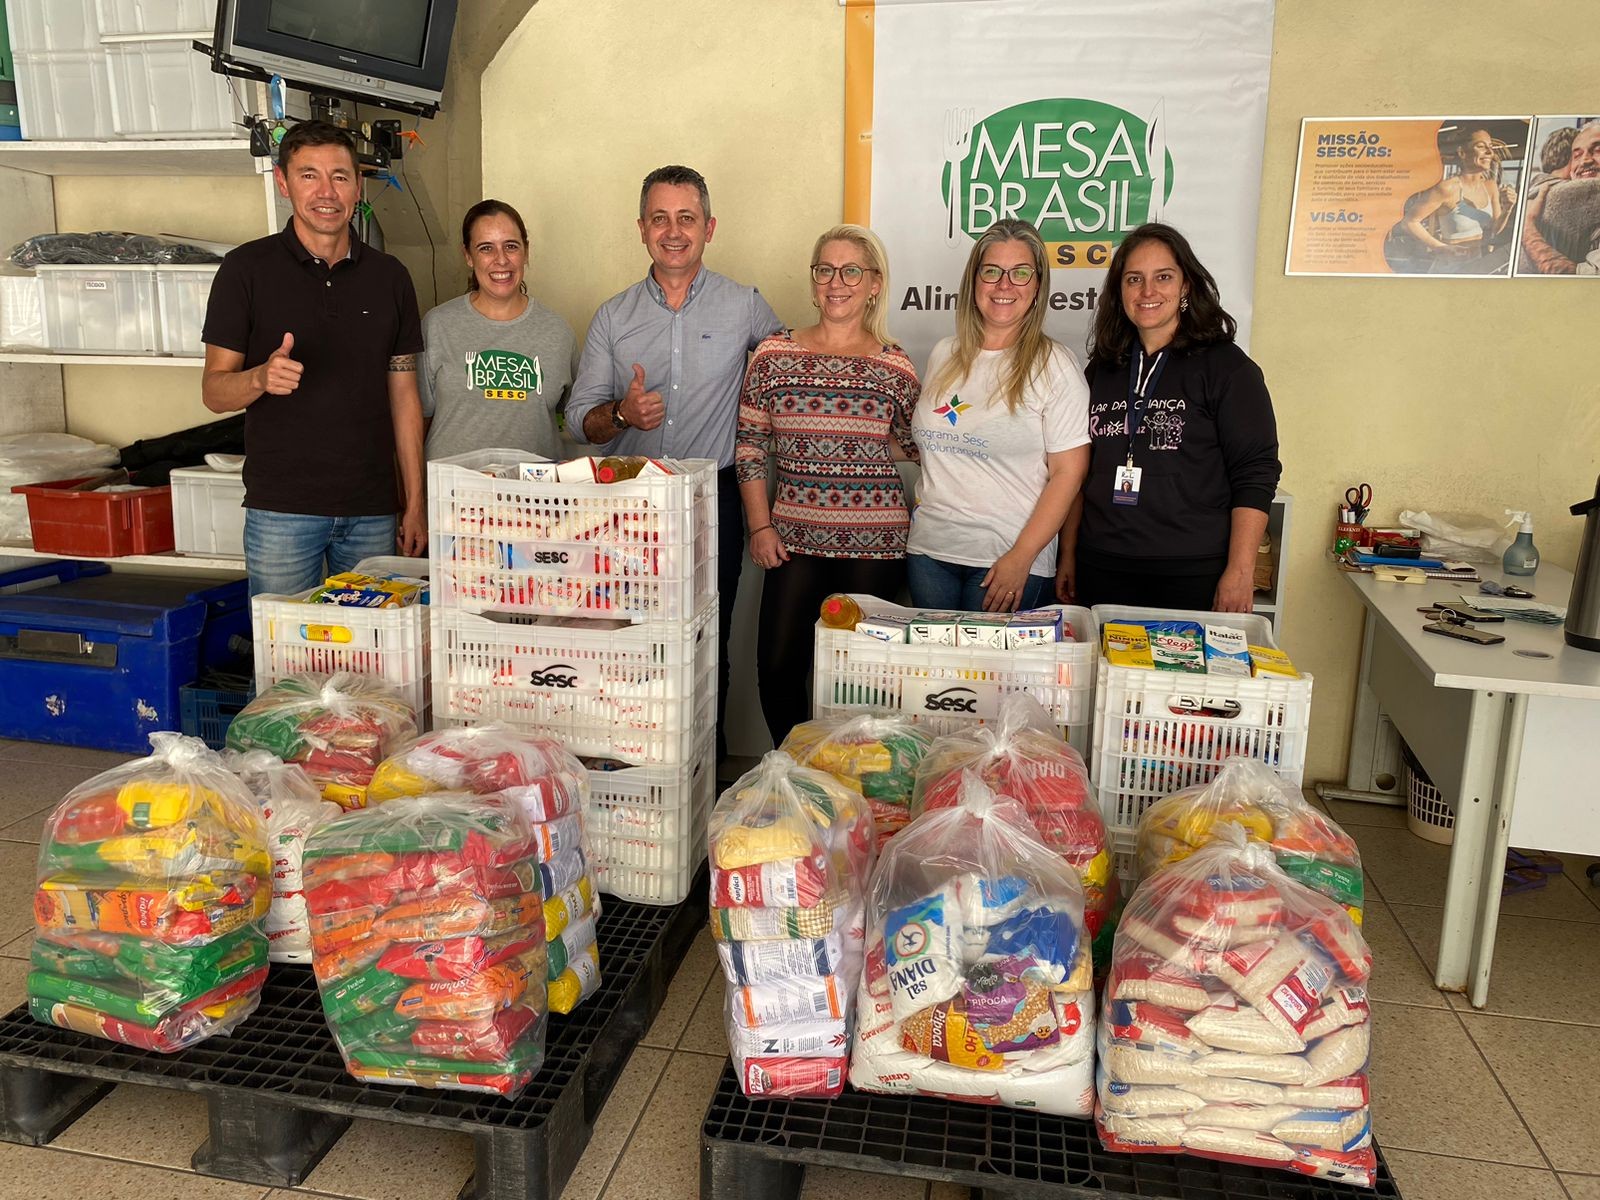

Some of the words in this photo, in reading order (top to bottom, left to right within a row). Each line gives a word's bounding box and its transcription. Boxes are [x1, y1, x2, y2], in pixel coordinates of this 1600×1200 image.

[1318, 131, 1380, 145] MISSÃO
[970, 119, 1143, 181] MESA
[1316, 146, 1392, 159] SESC/RS:
[968, 180, 1140, 234] BRASIL
[1310, 209, 1363, 223] VISÃO:
[476, 354, 534, 375] MESA
[475, 370, 535, 389] BRASIL
[486, 390, 524, 399] SESC
[1091, 403, 1108, 414] LAR
[1111, 401, 1127, 411] DA
[1134, 399, 1186, 412] CIANÇA
[962, 432, 990, 448] Sesc
[534, 551, 569, 564] SESC
[530, 664, 578, 688] Sesc
[924, 687, 977, 713] Sesc
[889, 958, 937, 992] DIANA
[906, 980, 928, 1001] sal
[971, 996, 1007, 1007] PIPOCA
[932, 1009, 946, 1048] Pipoca
